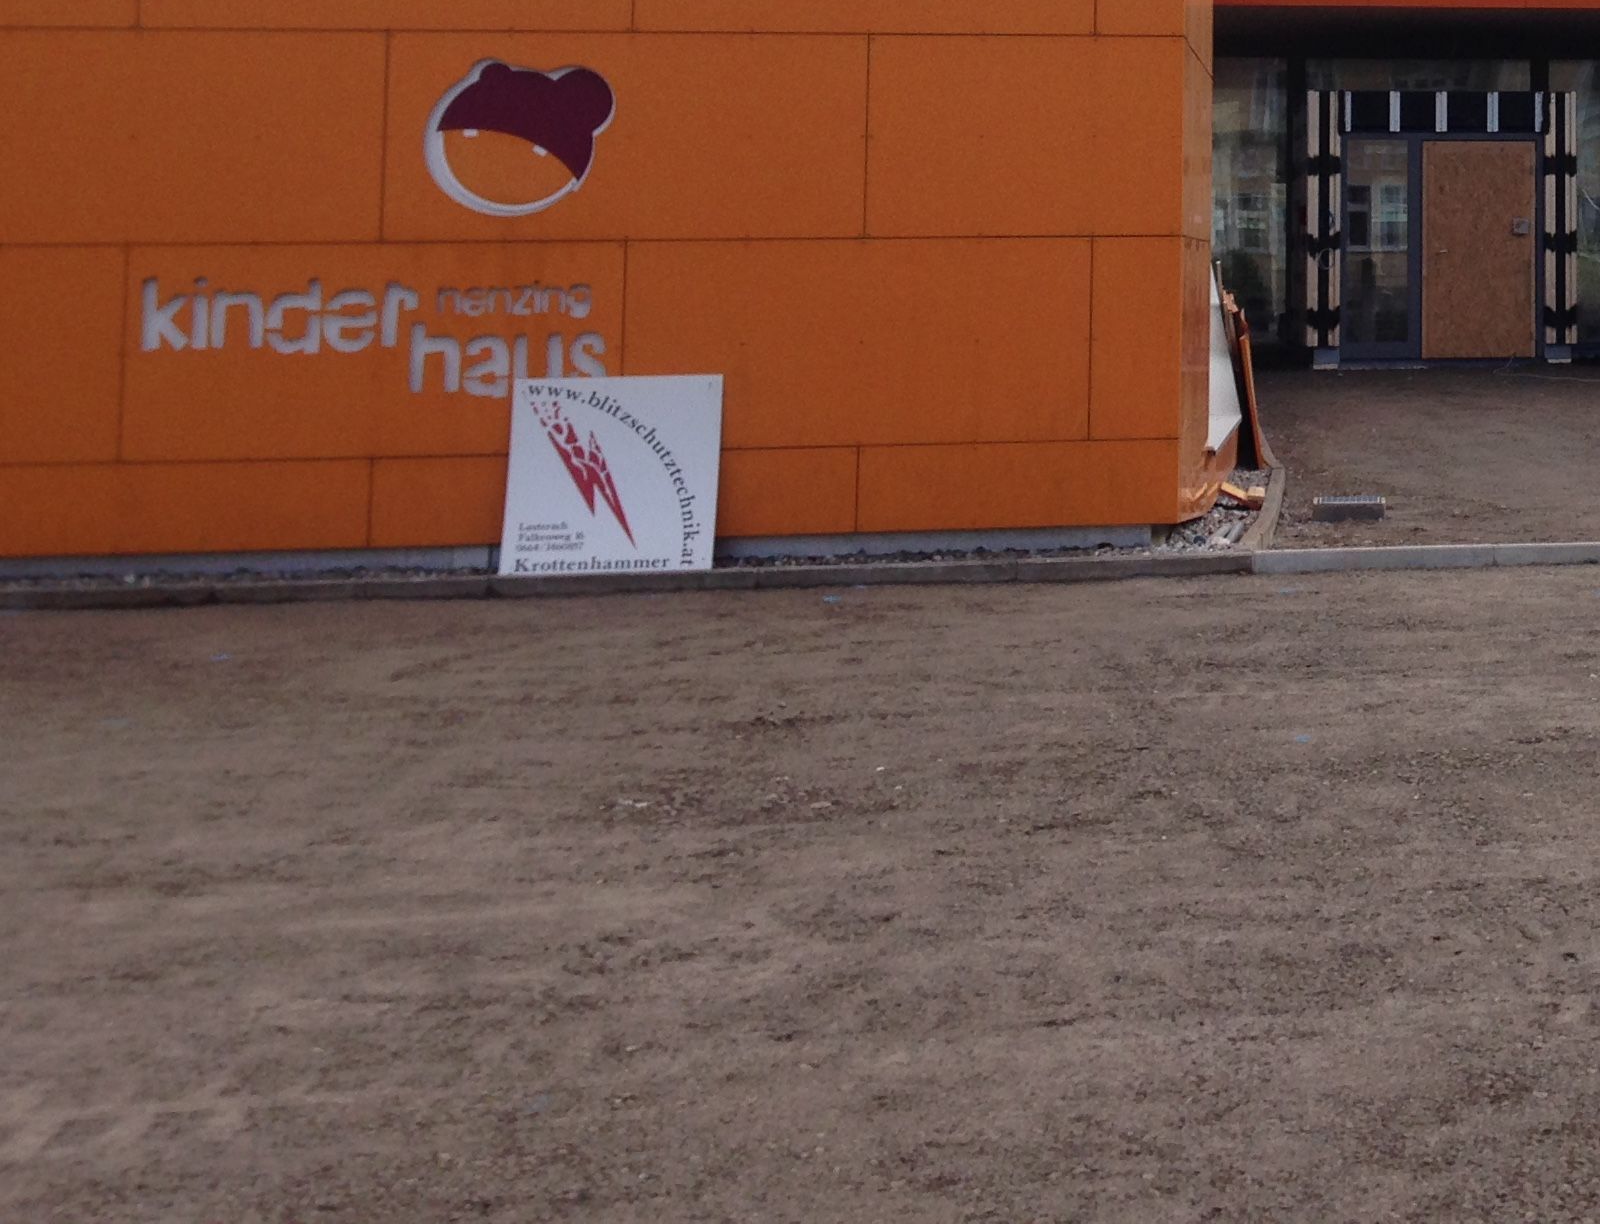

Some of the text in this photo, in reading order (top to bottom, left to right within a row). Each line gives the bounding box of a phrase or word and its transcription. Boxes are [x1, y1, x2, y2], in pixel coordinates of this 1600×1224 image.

[140, 278, 418, 353] kinder
[438, 281, 592, 318] nenzing
[409, 323, 606, 397] haus
[527, 384, 701, 566] www.blitzschutztechnik.at
[513, 555, 670, 573] Krottenhammer
